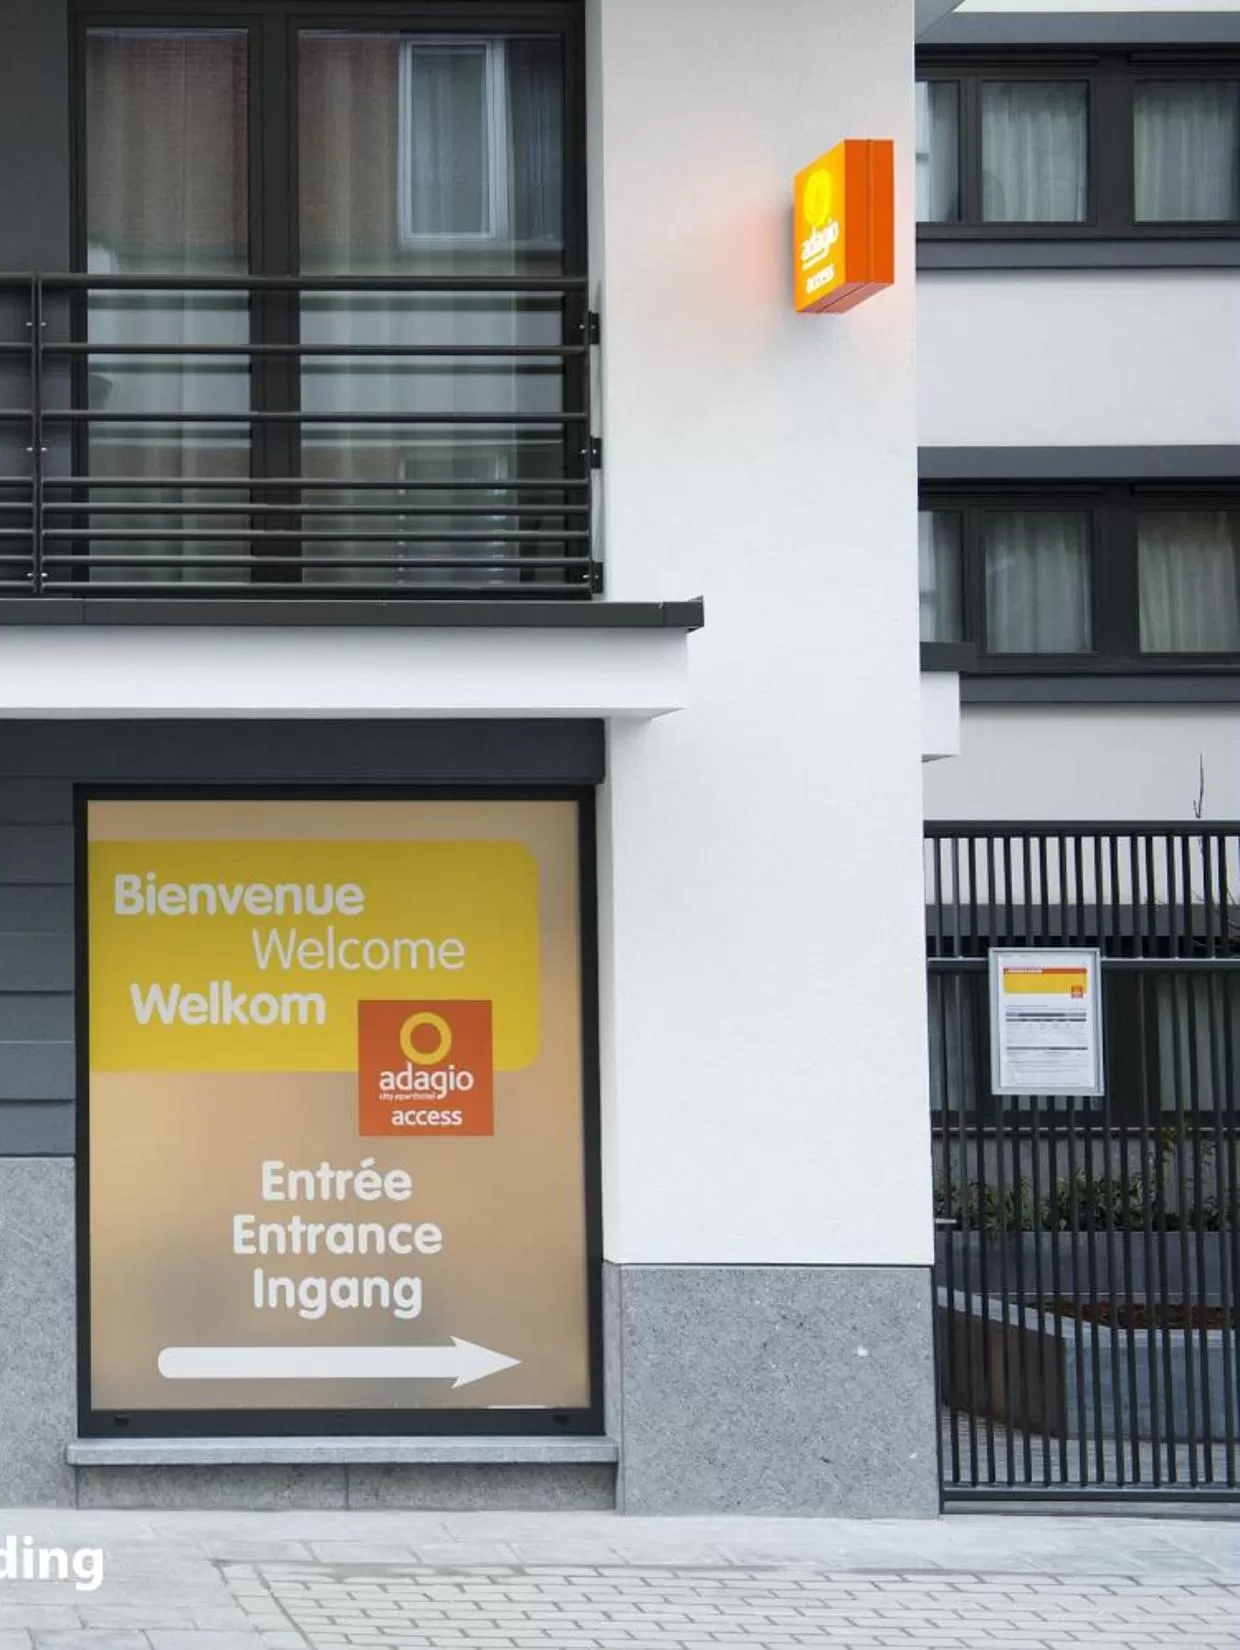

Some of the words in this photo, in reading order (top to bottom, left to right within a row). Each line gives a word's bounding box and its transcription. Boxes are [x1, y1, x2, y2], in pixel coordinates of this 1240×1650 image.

[114, 873, 365, 916] Bienvenue
[251, 927, 466, 971] Welcome
[129, 982, 326, 1025] Welkom
[379, 1062, 474, 1099] adagio
[391, 1109, 463, 1125] access
[261, 1157, 412, 1200] Entrée
[233, 1215, 442, 1254] Entrance
[254, 1268, 422, 1319] Ingang
